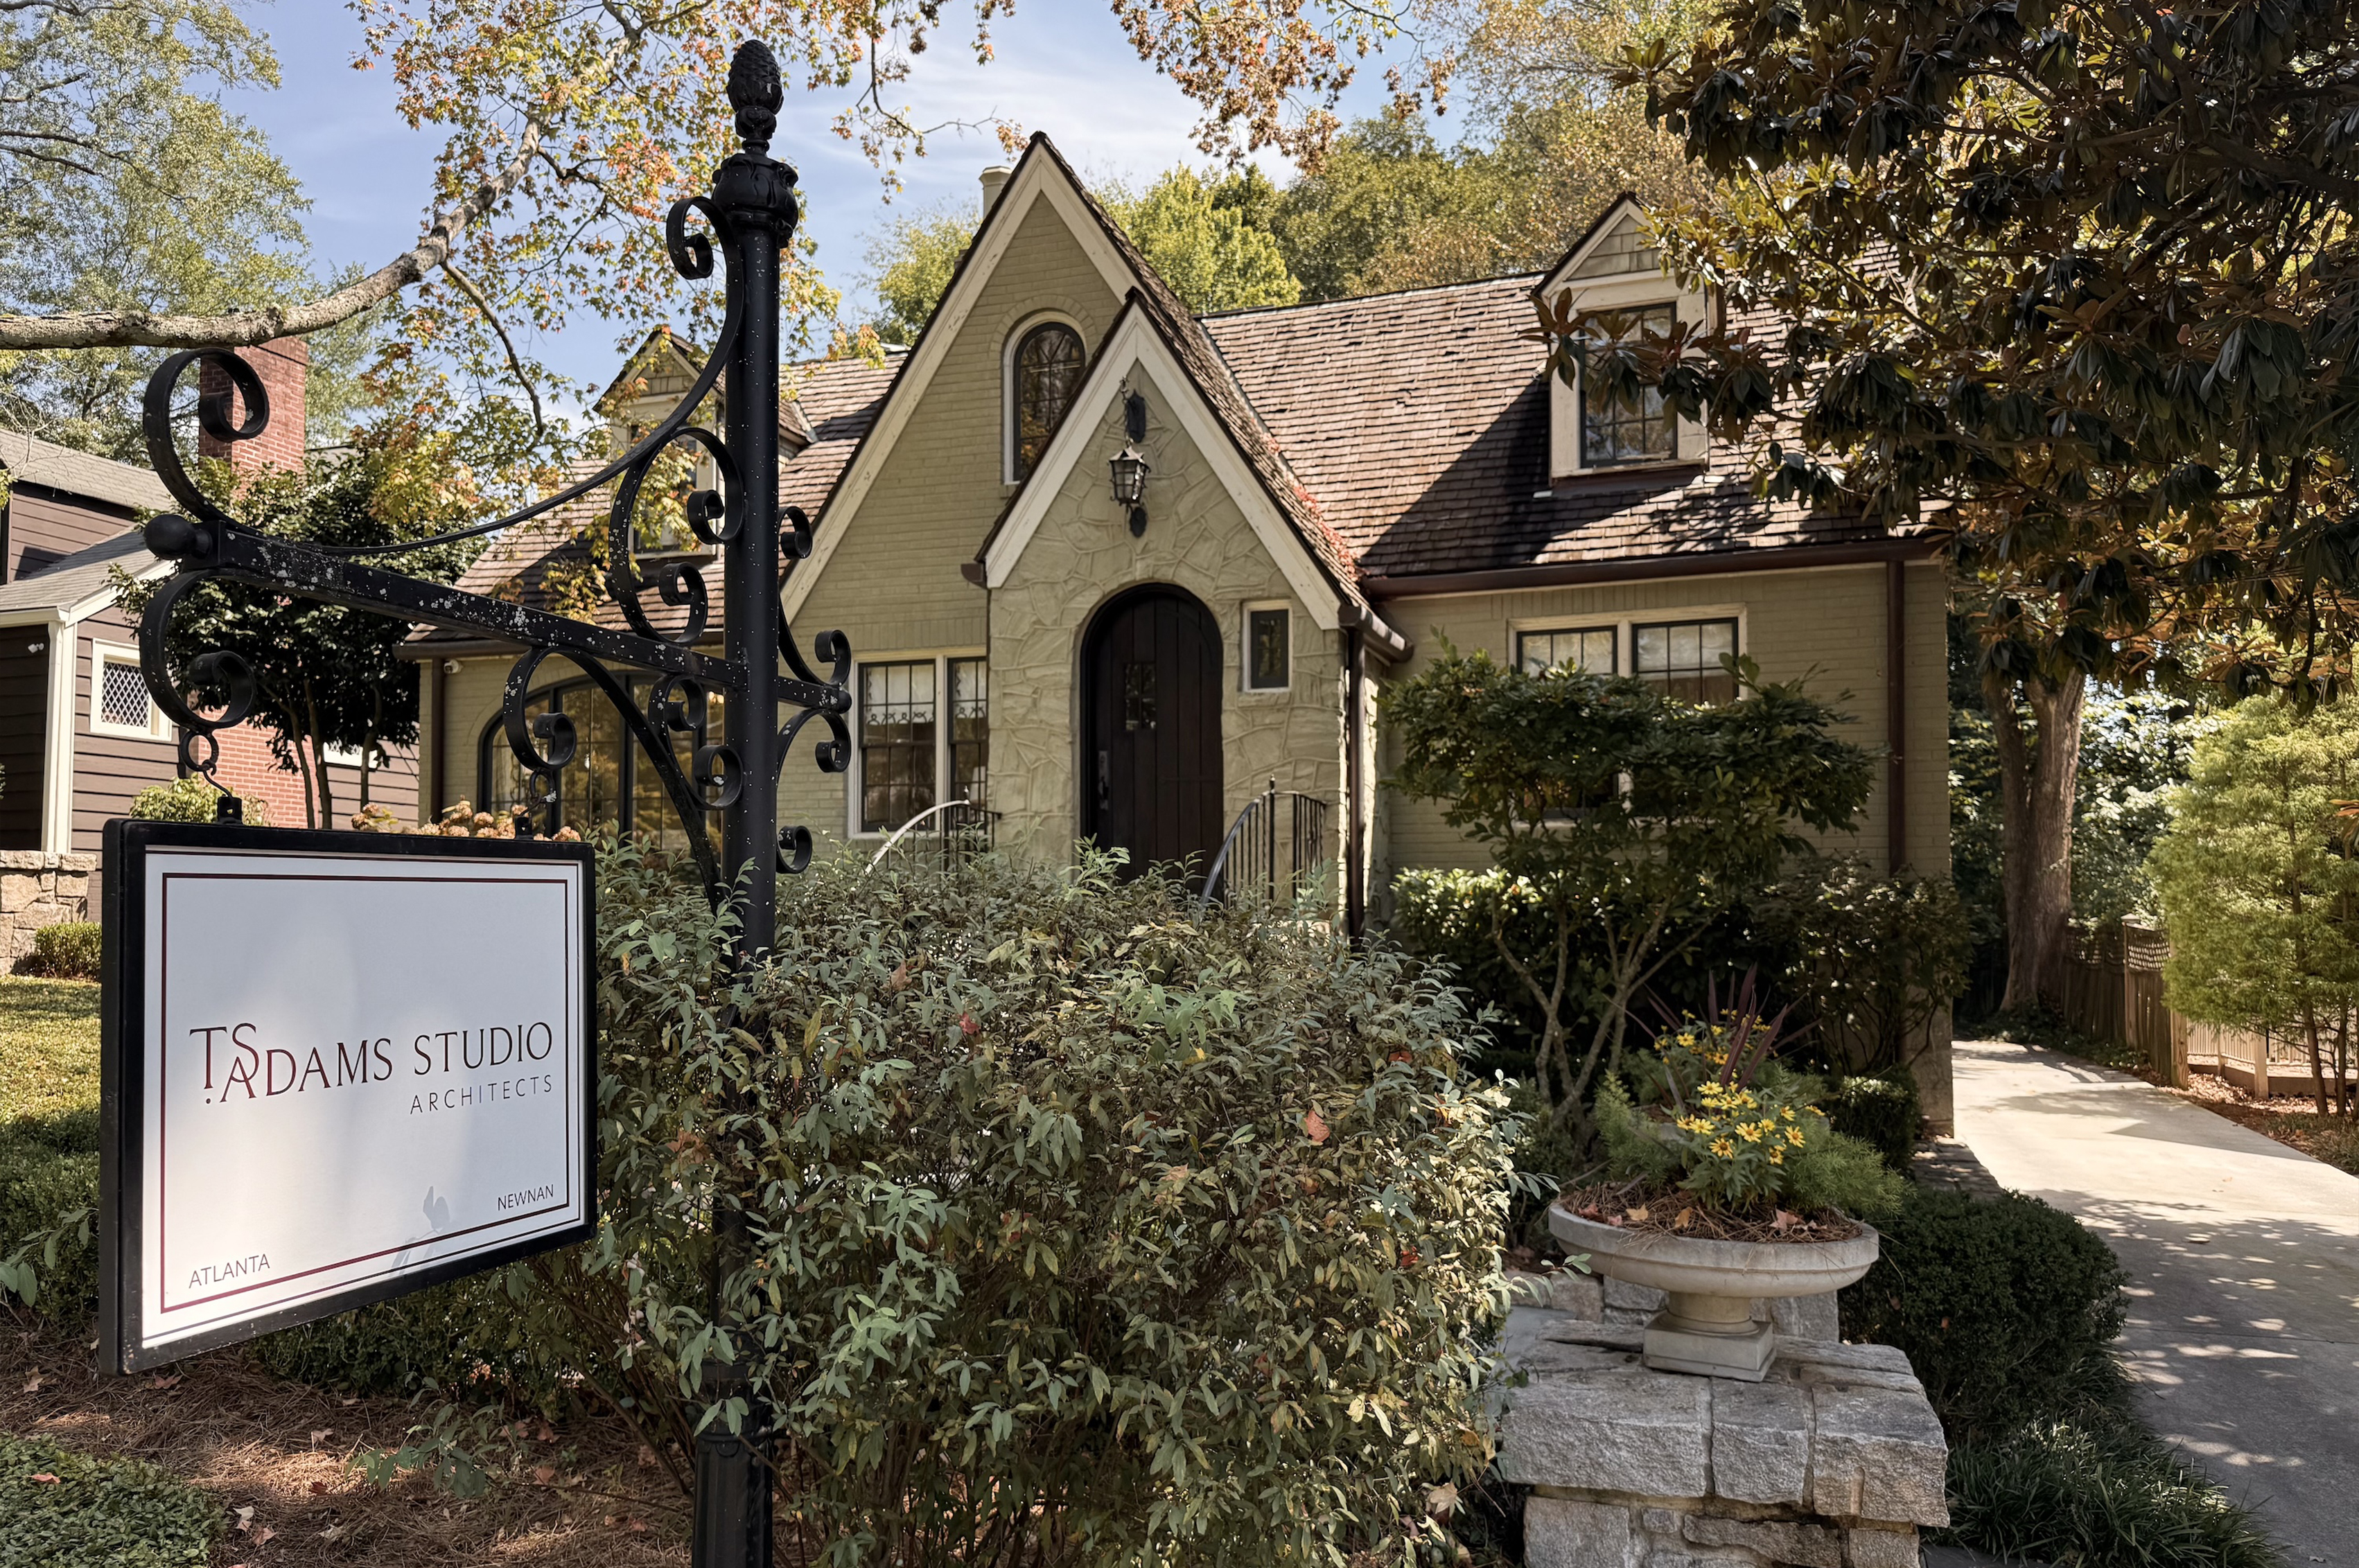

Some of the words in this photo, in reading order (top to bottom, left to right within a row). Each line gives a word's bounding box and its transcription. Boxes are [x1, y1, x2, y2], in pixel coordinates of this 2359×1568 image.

[413, 1021, 553, 1075] STUDIO
[410, 1074, 552, 1115] ARCHITECTS
[497, 1183, 554, 1211] NEWNAN
[188, 1253, 271, 1289] ATLANTA
